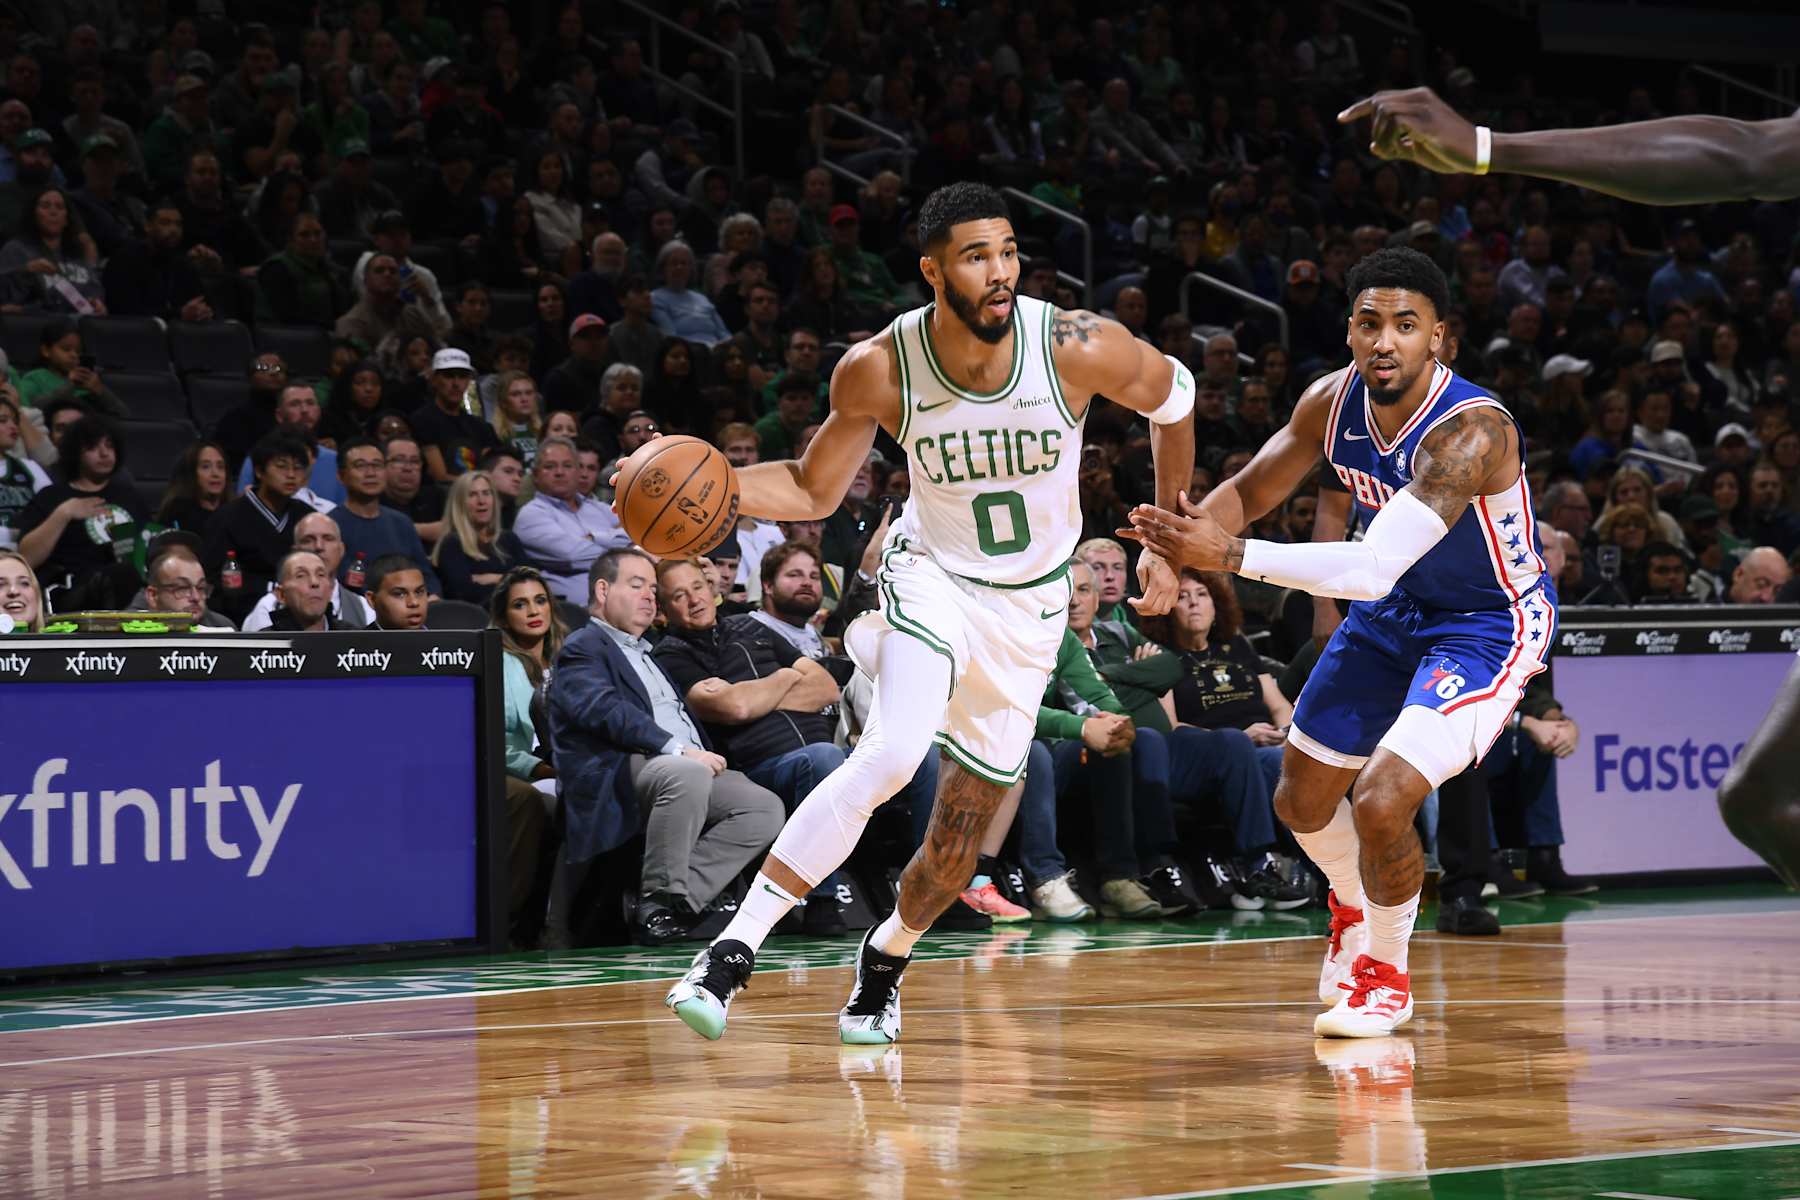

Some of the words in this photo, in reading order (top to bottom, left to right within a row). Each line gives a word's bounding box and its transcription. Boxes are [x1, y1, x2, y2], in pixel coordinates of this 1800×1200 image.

[1013, 396, 1050, 409] Amica
[915, 429, 1062, 484] CELTICS
[971, 490, 1031, 556] 0
[0, 653, 31, 676] nity
[66, 651, 126, 675] xfinity
[160, 650, 218, 675] xfinity
[250, 650, 306, 673] xfinity
[337, 648, 392, 671] xfinity
[421, 647, 474, 670] xfinity
[1423, 666, 1466, 700] 76
[1594, 734, 1746, 792] Faste
